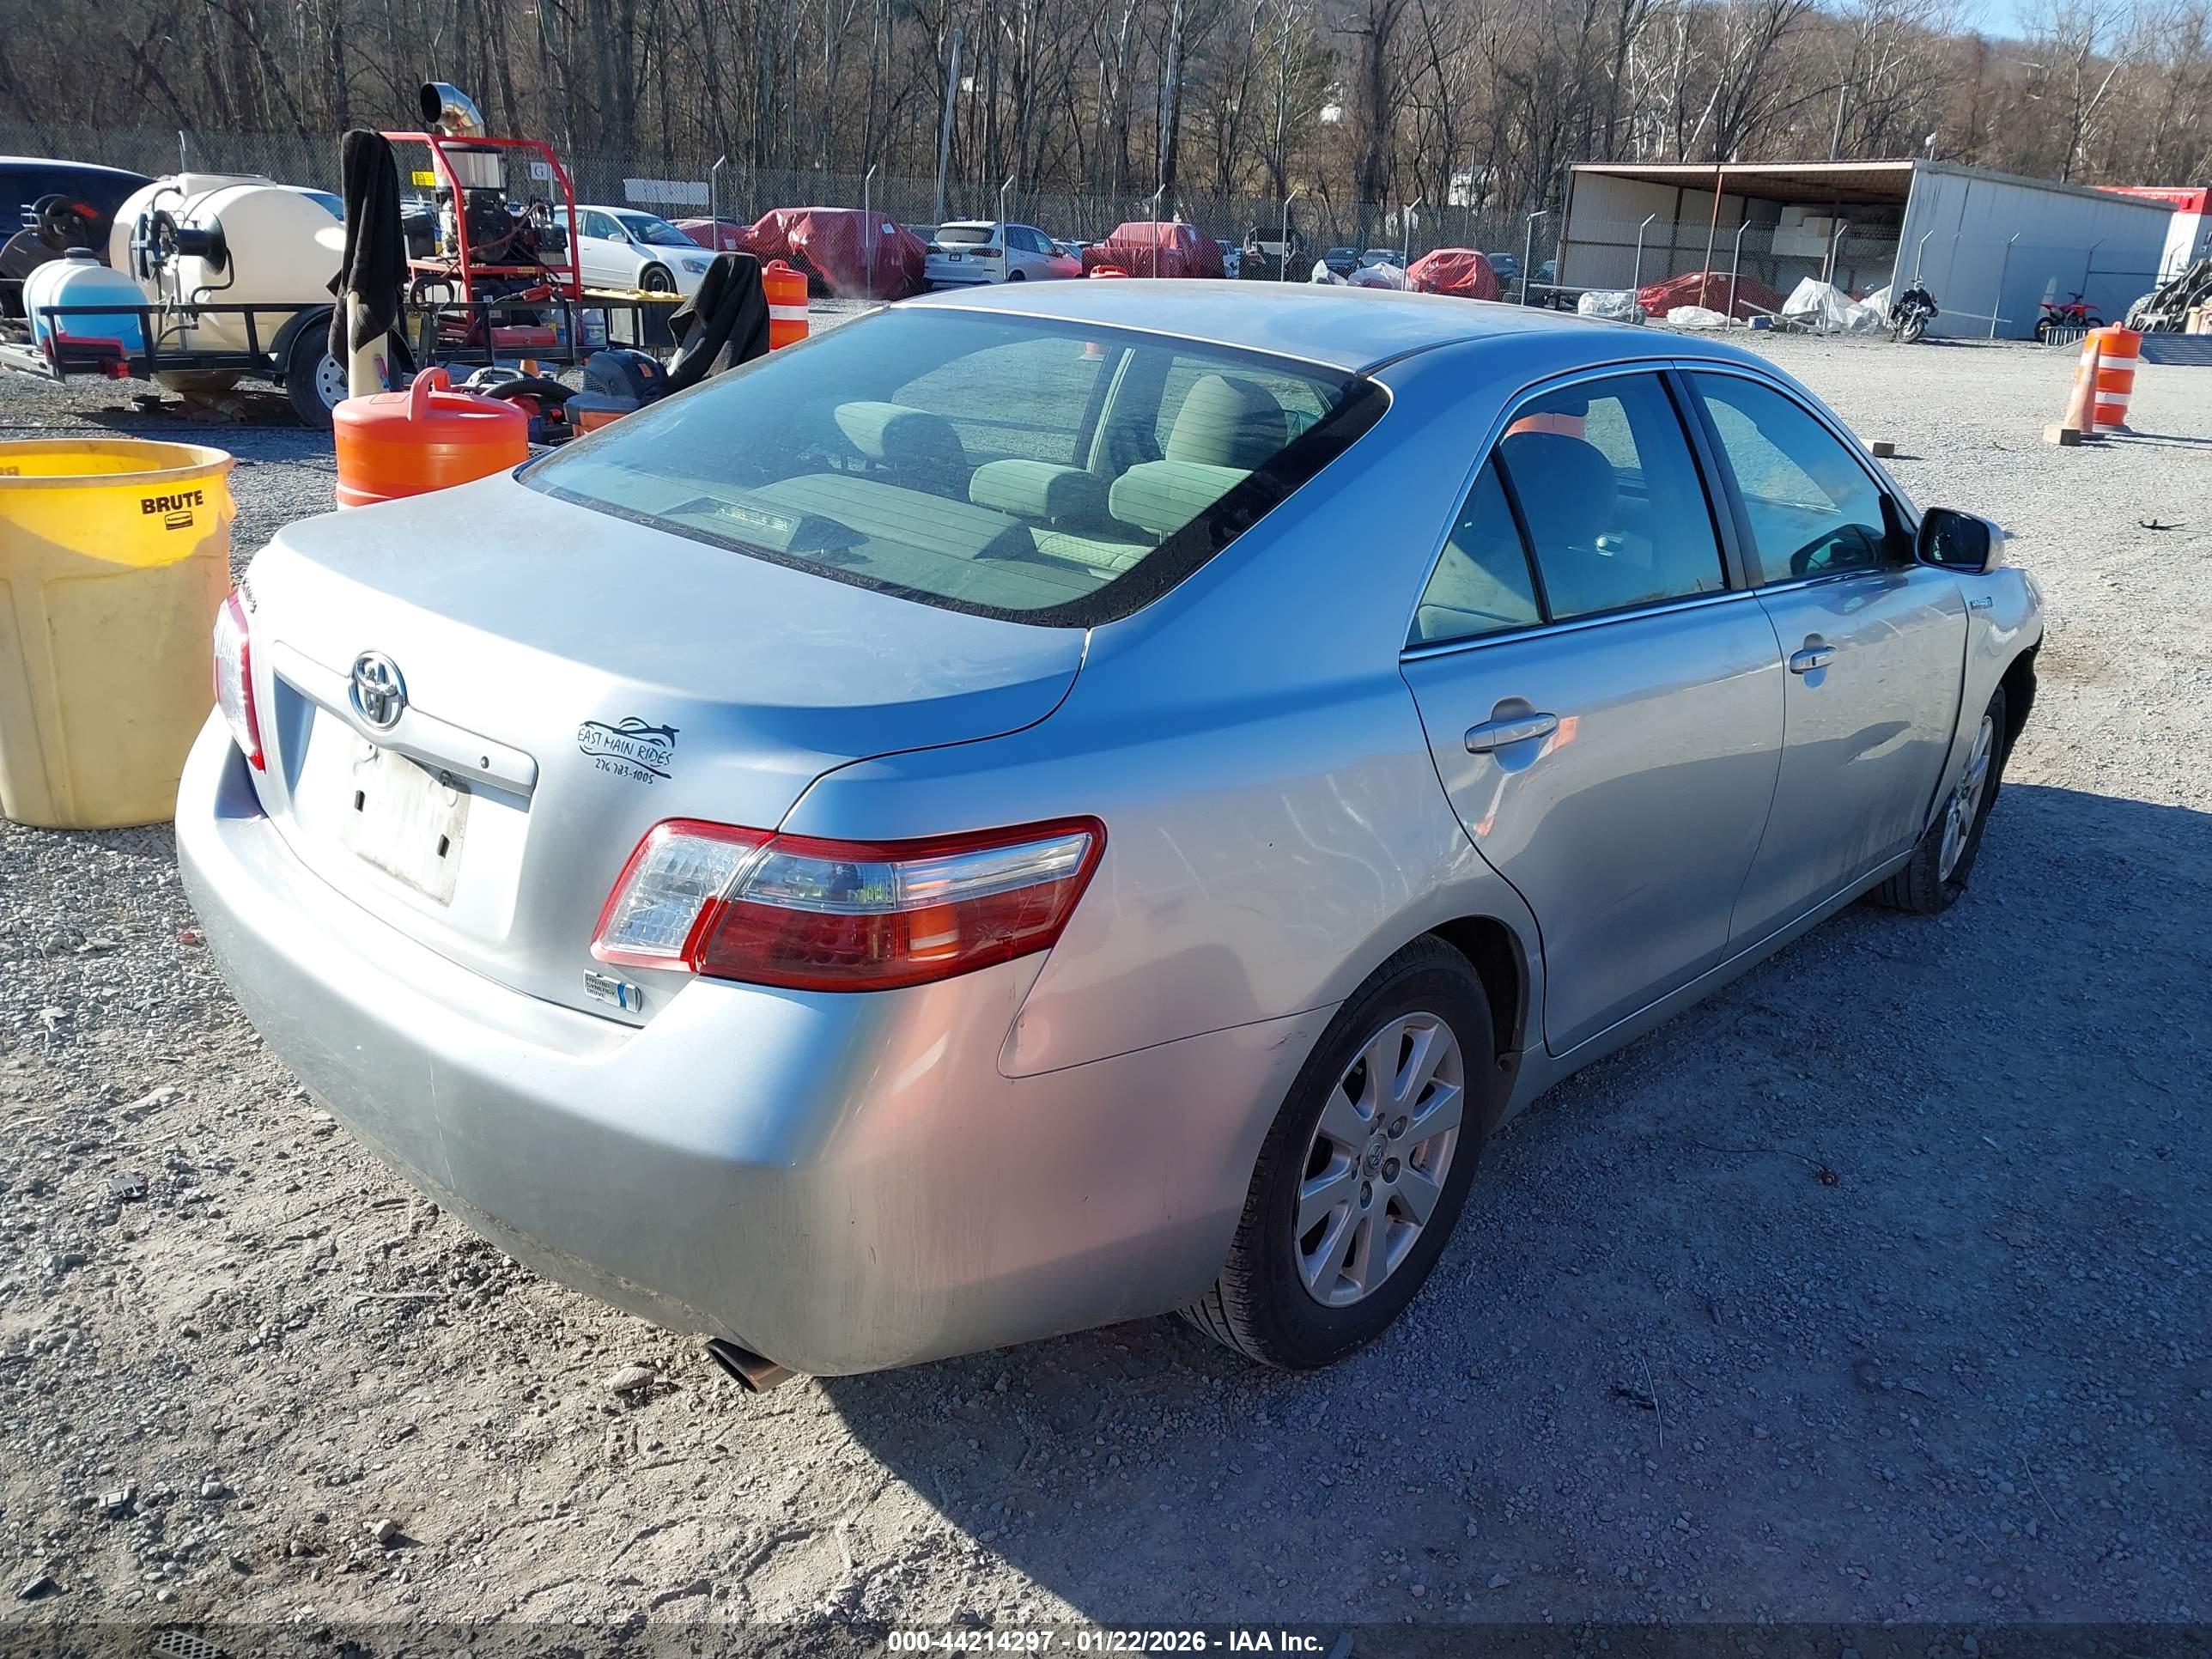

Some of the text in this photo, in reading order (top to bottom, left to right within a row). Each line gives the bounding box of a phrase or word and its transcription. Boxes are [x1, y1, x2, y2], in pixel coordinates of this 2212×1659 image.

[534, 166, 544, 177] G
[141, 489, 204, 515] BRUTE
[578, 728, 673, 766] EAST MAIN RIDES
[595, 758, 654, 784] 276 783-1005
[586, 976, 610, 988] HYBRID
[586, 982, 615, 996] SYNERGY
[586, 988, 605, 997] DRIVE
